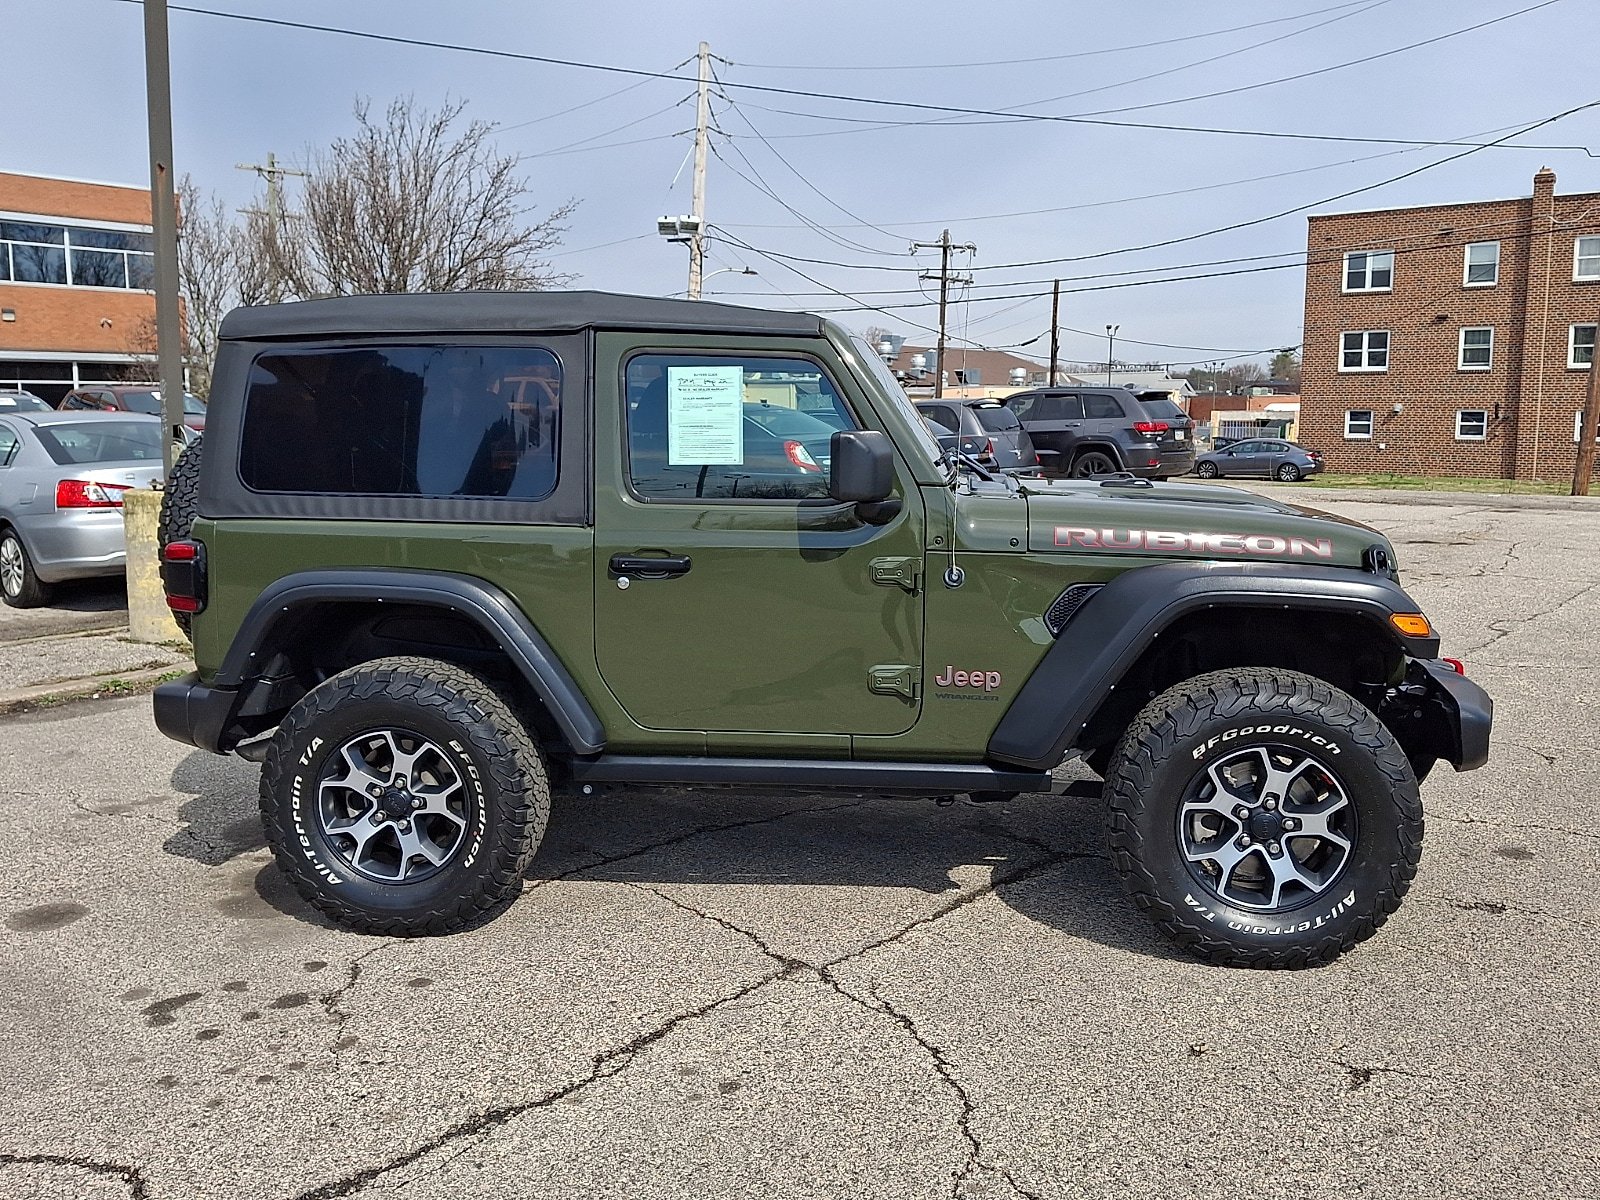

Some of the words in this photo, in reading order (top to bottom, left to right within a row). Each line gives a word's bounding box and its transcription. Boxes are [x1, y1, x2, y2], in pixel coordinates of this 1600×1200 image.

[1054, 526, 1333, 558] RUBICON
[935, 665, 1002, 692] Jeep
[935, 692, 999, 701] WRANGLER
[298, 736, 324, 768] T/A
[1191, 723, 1342, 760] BFGoodrich
[447, 738, 489, 869] BFGoodrich
[290, 775, 344, 887] All-Terrain
[1183, 892, 1216, 924] T/A
[1228, 889, 1357, 937] All-Terrain
